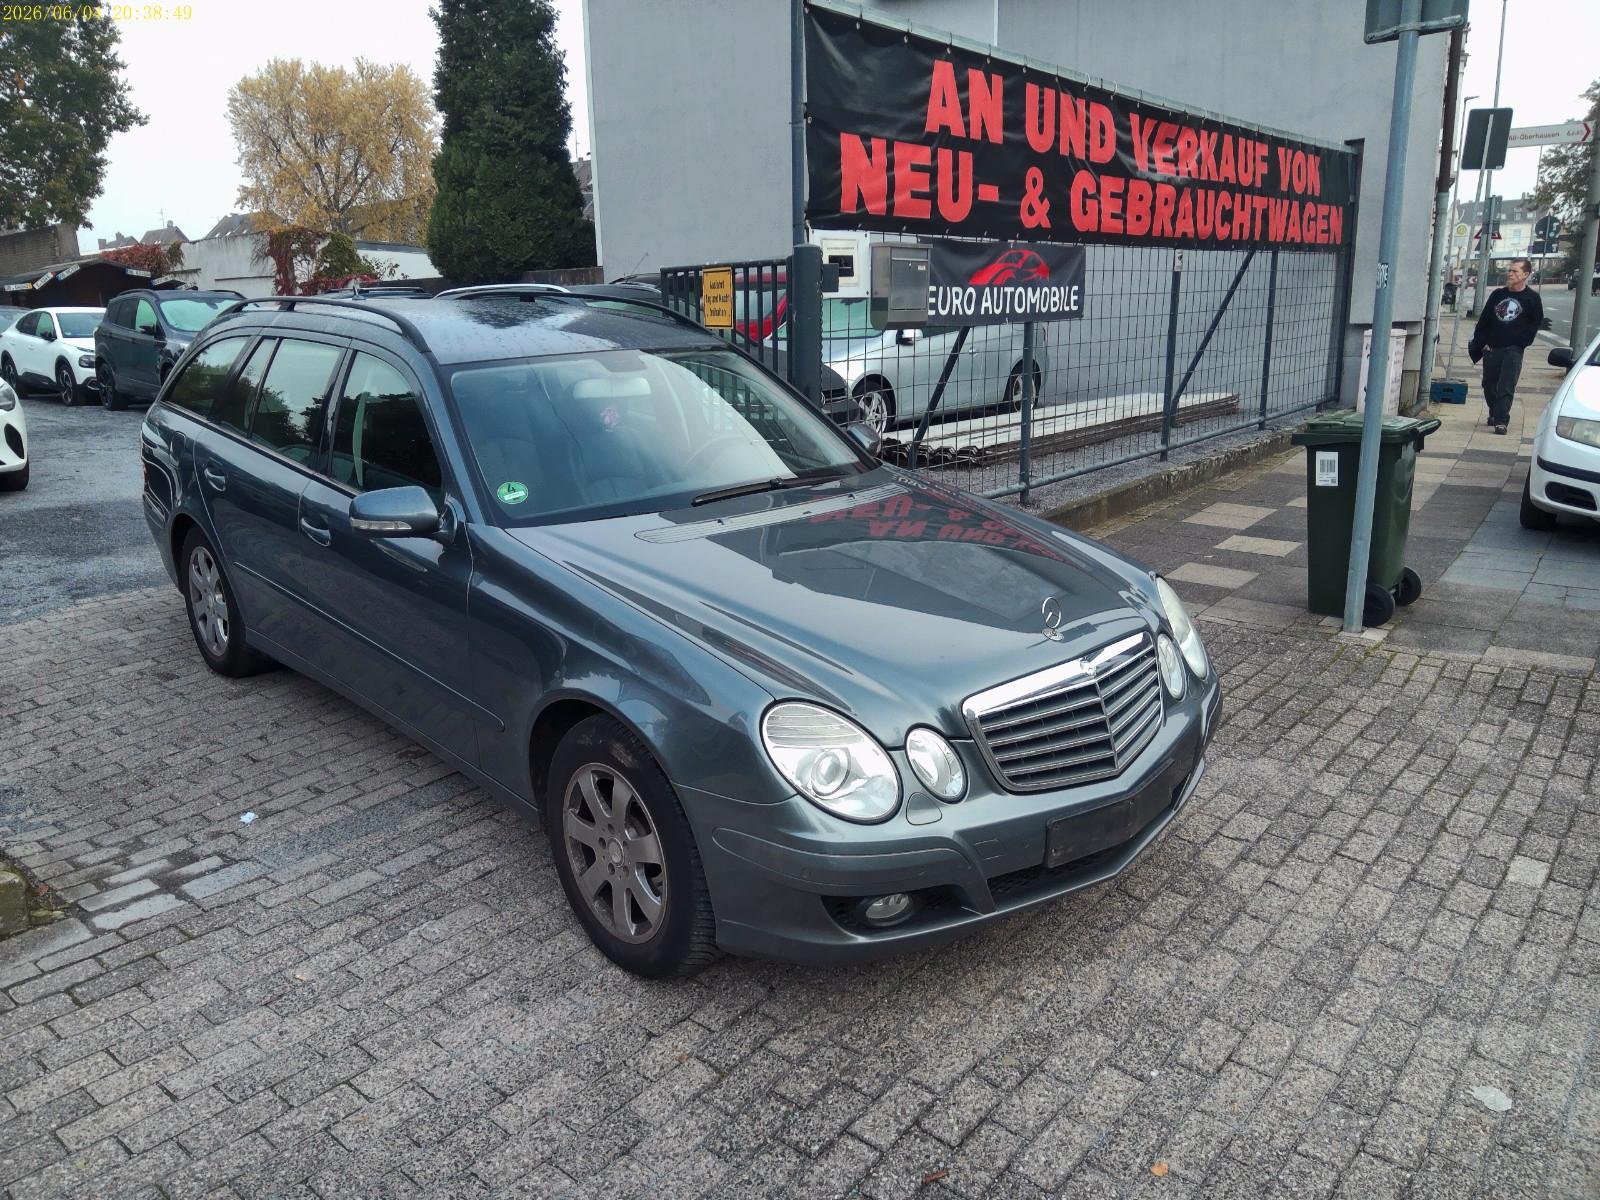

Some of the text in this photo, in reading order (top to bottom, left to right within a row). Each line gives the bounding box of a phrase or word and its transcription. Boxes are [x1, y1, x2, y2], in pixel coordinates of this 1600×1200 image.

[924, 59, 1321, 197] AN UND VERKAUF VON
[839, 132, 1344, 245] NEU- & GEBRAUCHTWAGEN
[927, 285, 1079, 316] EURO AUTOMOBILE
